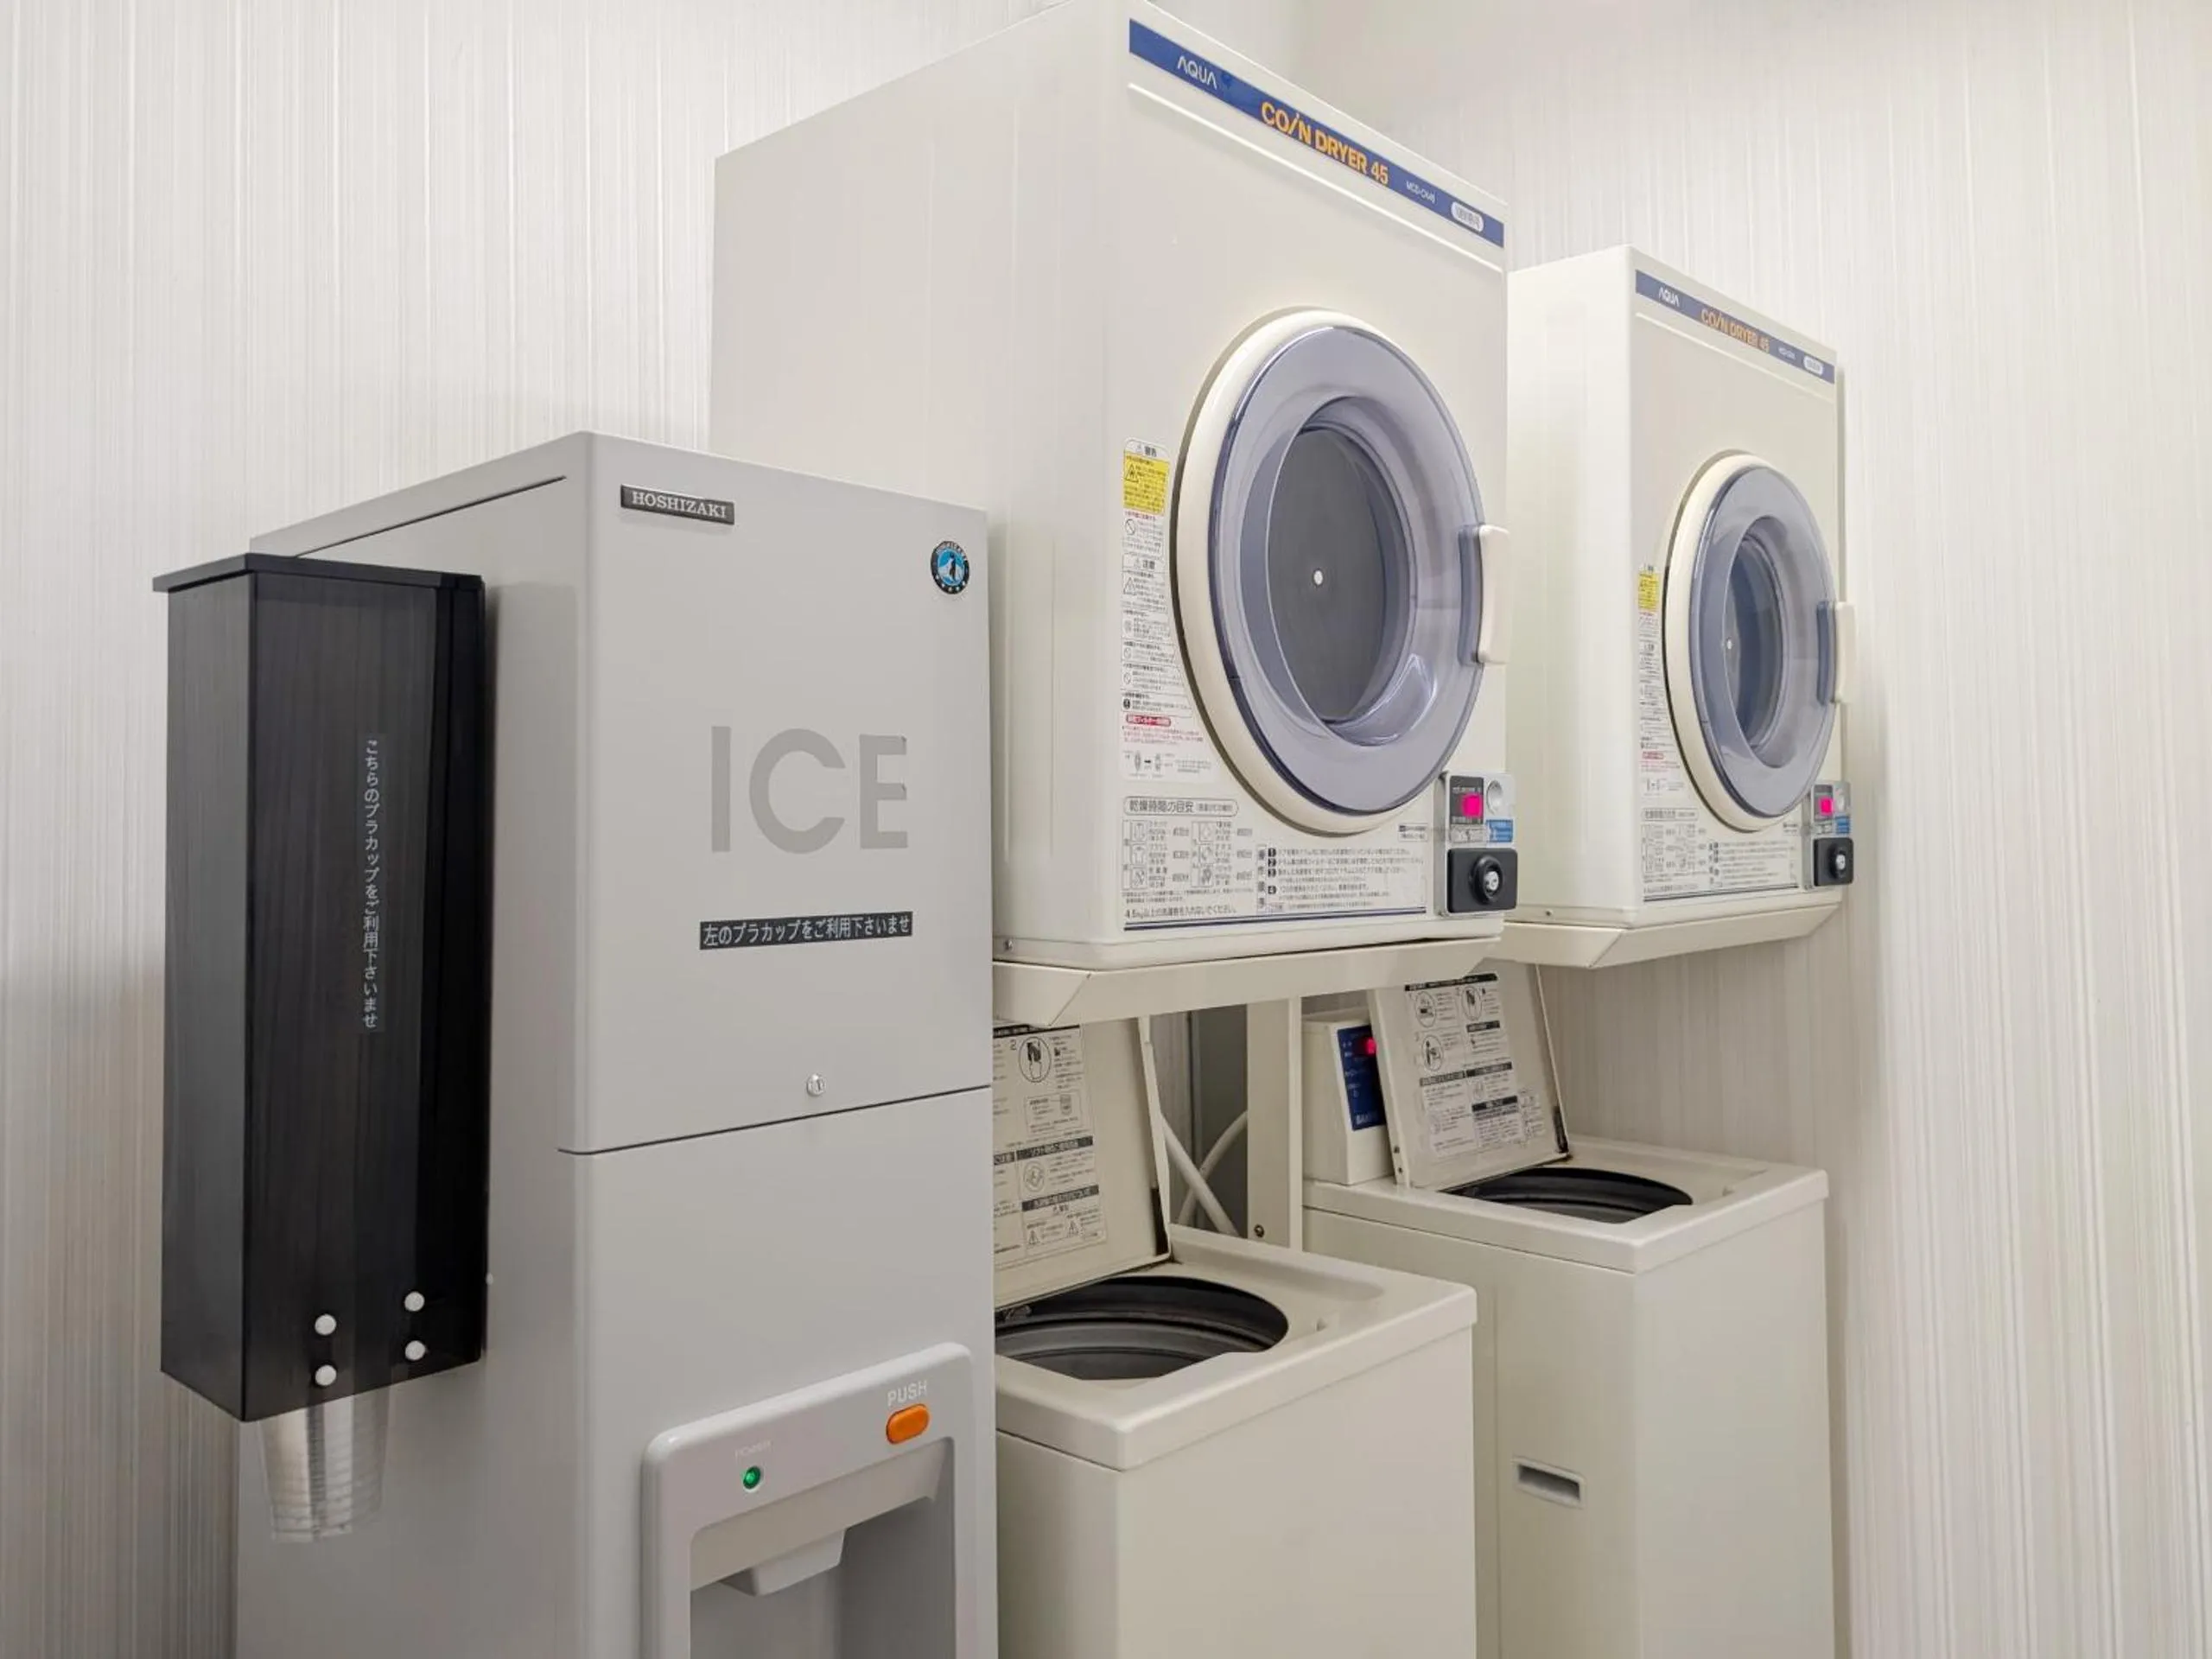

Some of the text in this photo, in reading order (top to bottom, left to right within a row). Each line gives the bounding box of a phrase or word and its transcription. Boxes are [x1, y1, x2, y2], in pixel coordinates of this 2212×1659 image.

[1176, 55, 1218, 90] AQUA
[1314, 129, 1368, 174] DRYER
[1370, 161, 1389, 187] 45
[1658, 286, 1680, 307] AQUA
[631, 490, 728, 519] HOSHIZAKI
[710, 725, 909, 855] ICE
[362, 739, 381, 1029] こちらのプラカップをご利用下さいませ
[702, 913, 912, 947] 左のプラカップをご利用下さいませ
[887, 1381, 928, 1407] PUSH
